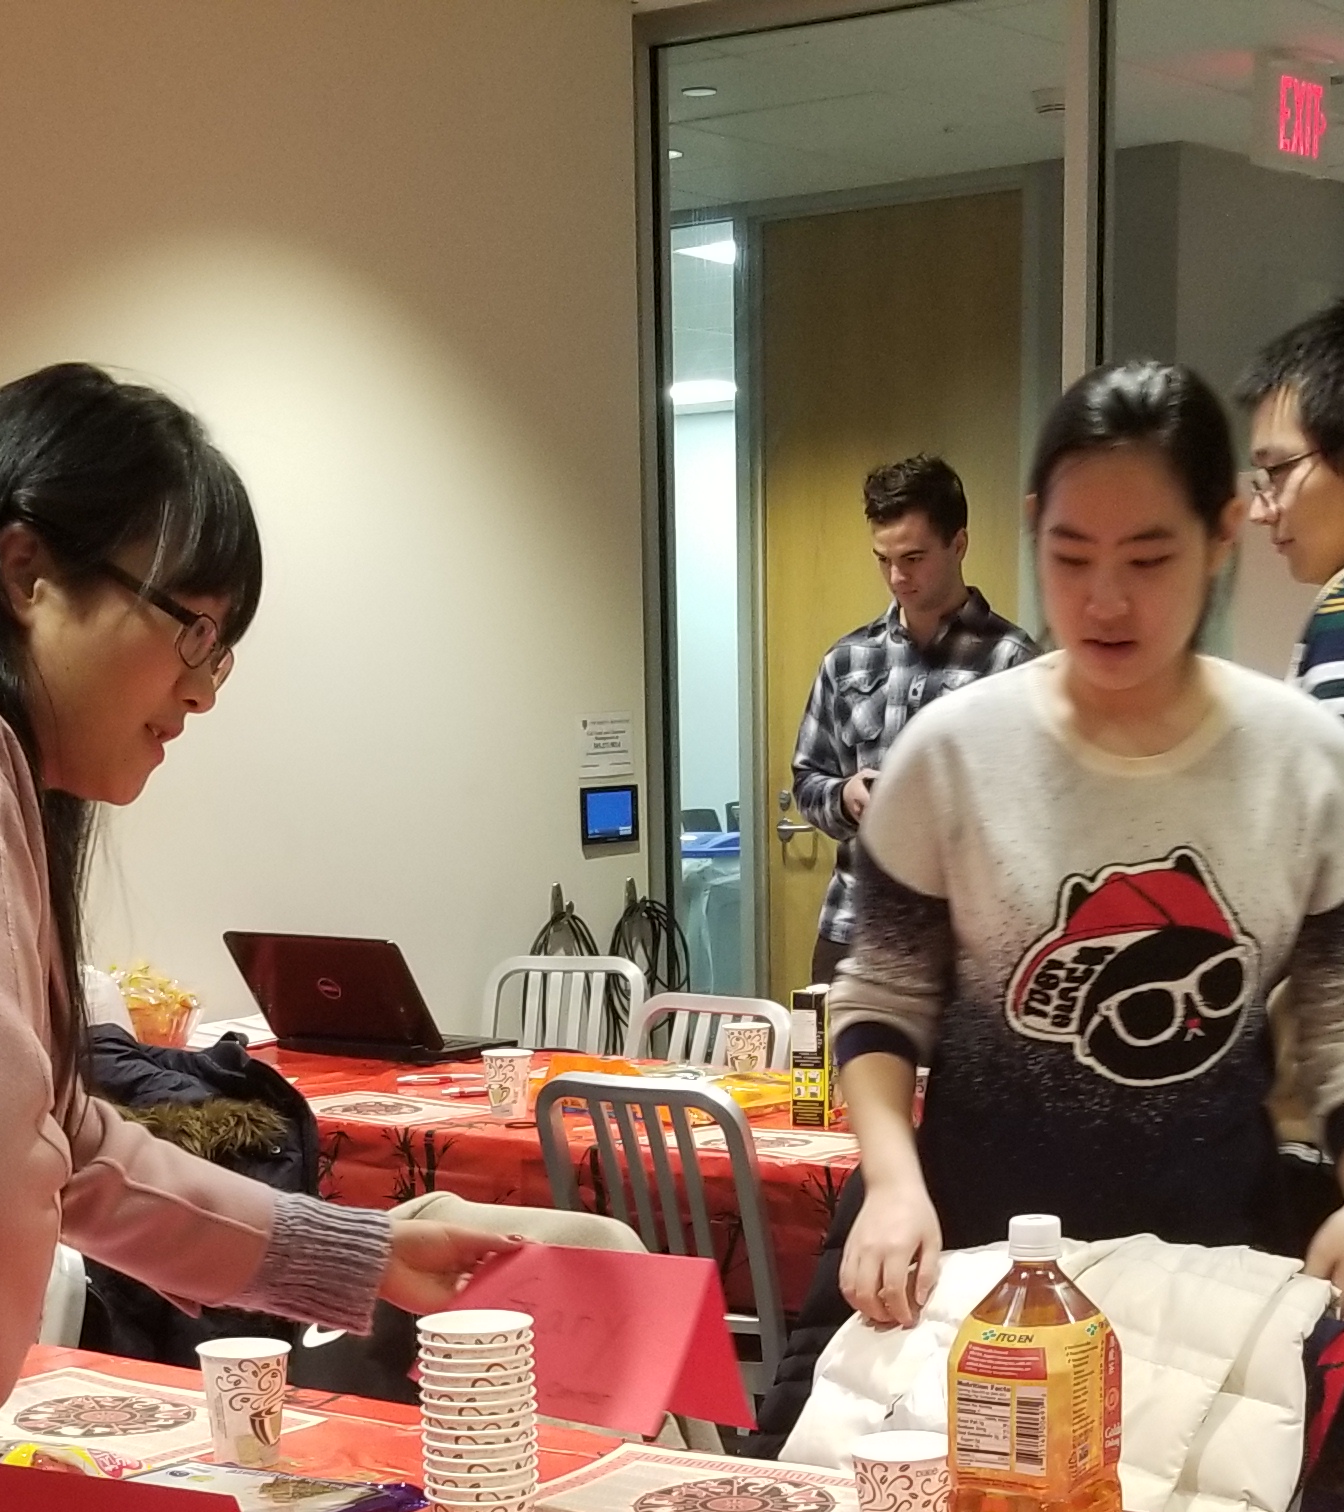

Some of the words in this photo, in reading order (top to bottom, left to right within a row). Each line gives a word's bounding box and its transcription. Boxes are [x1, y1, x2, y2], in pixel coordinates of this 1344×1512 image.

[1279, 74, 1325, 159] EXIT
[995, 1333, 1018, 1343] ITO
[1017, 1334, 1035, 1343] EN
